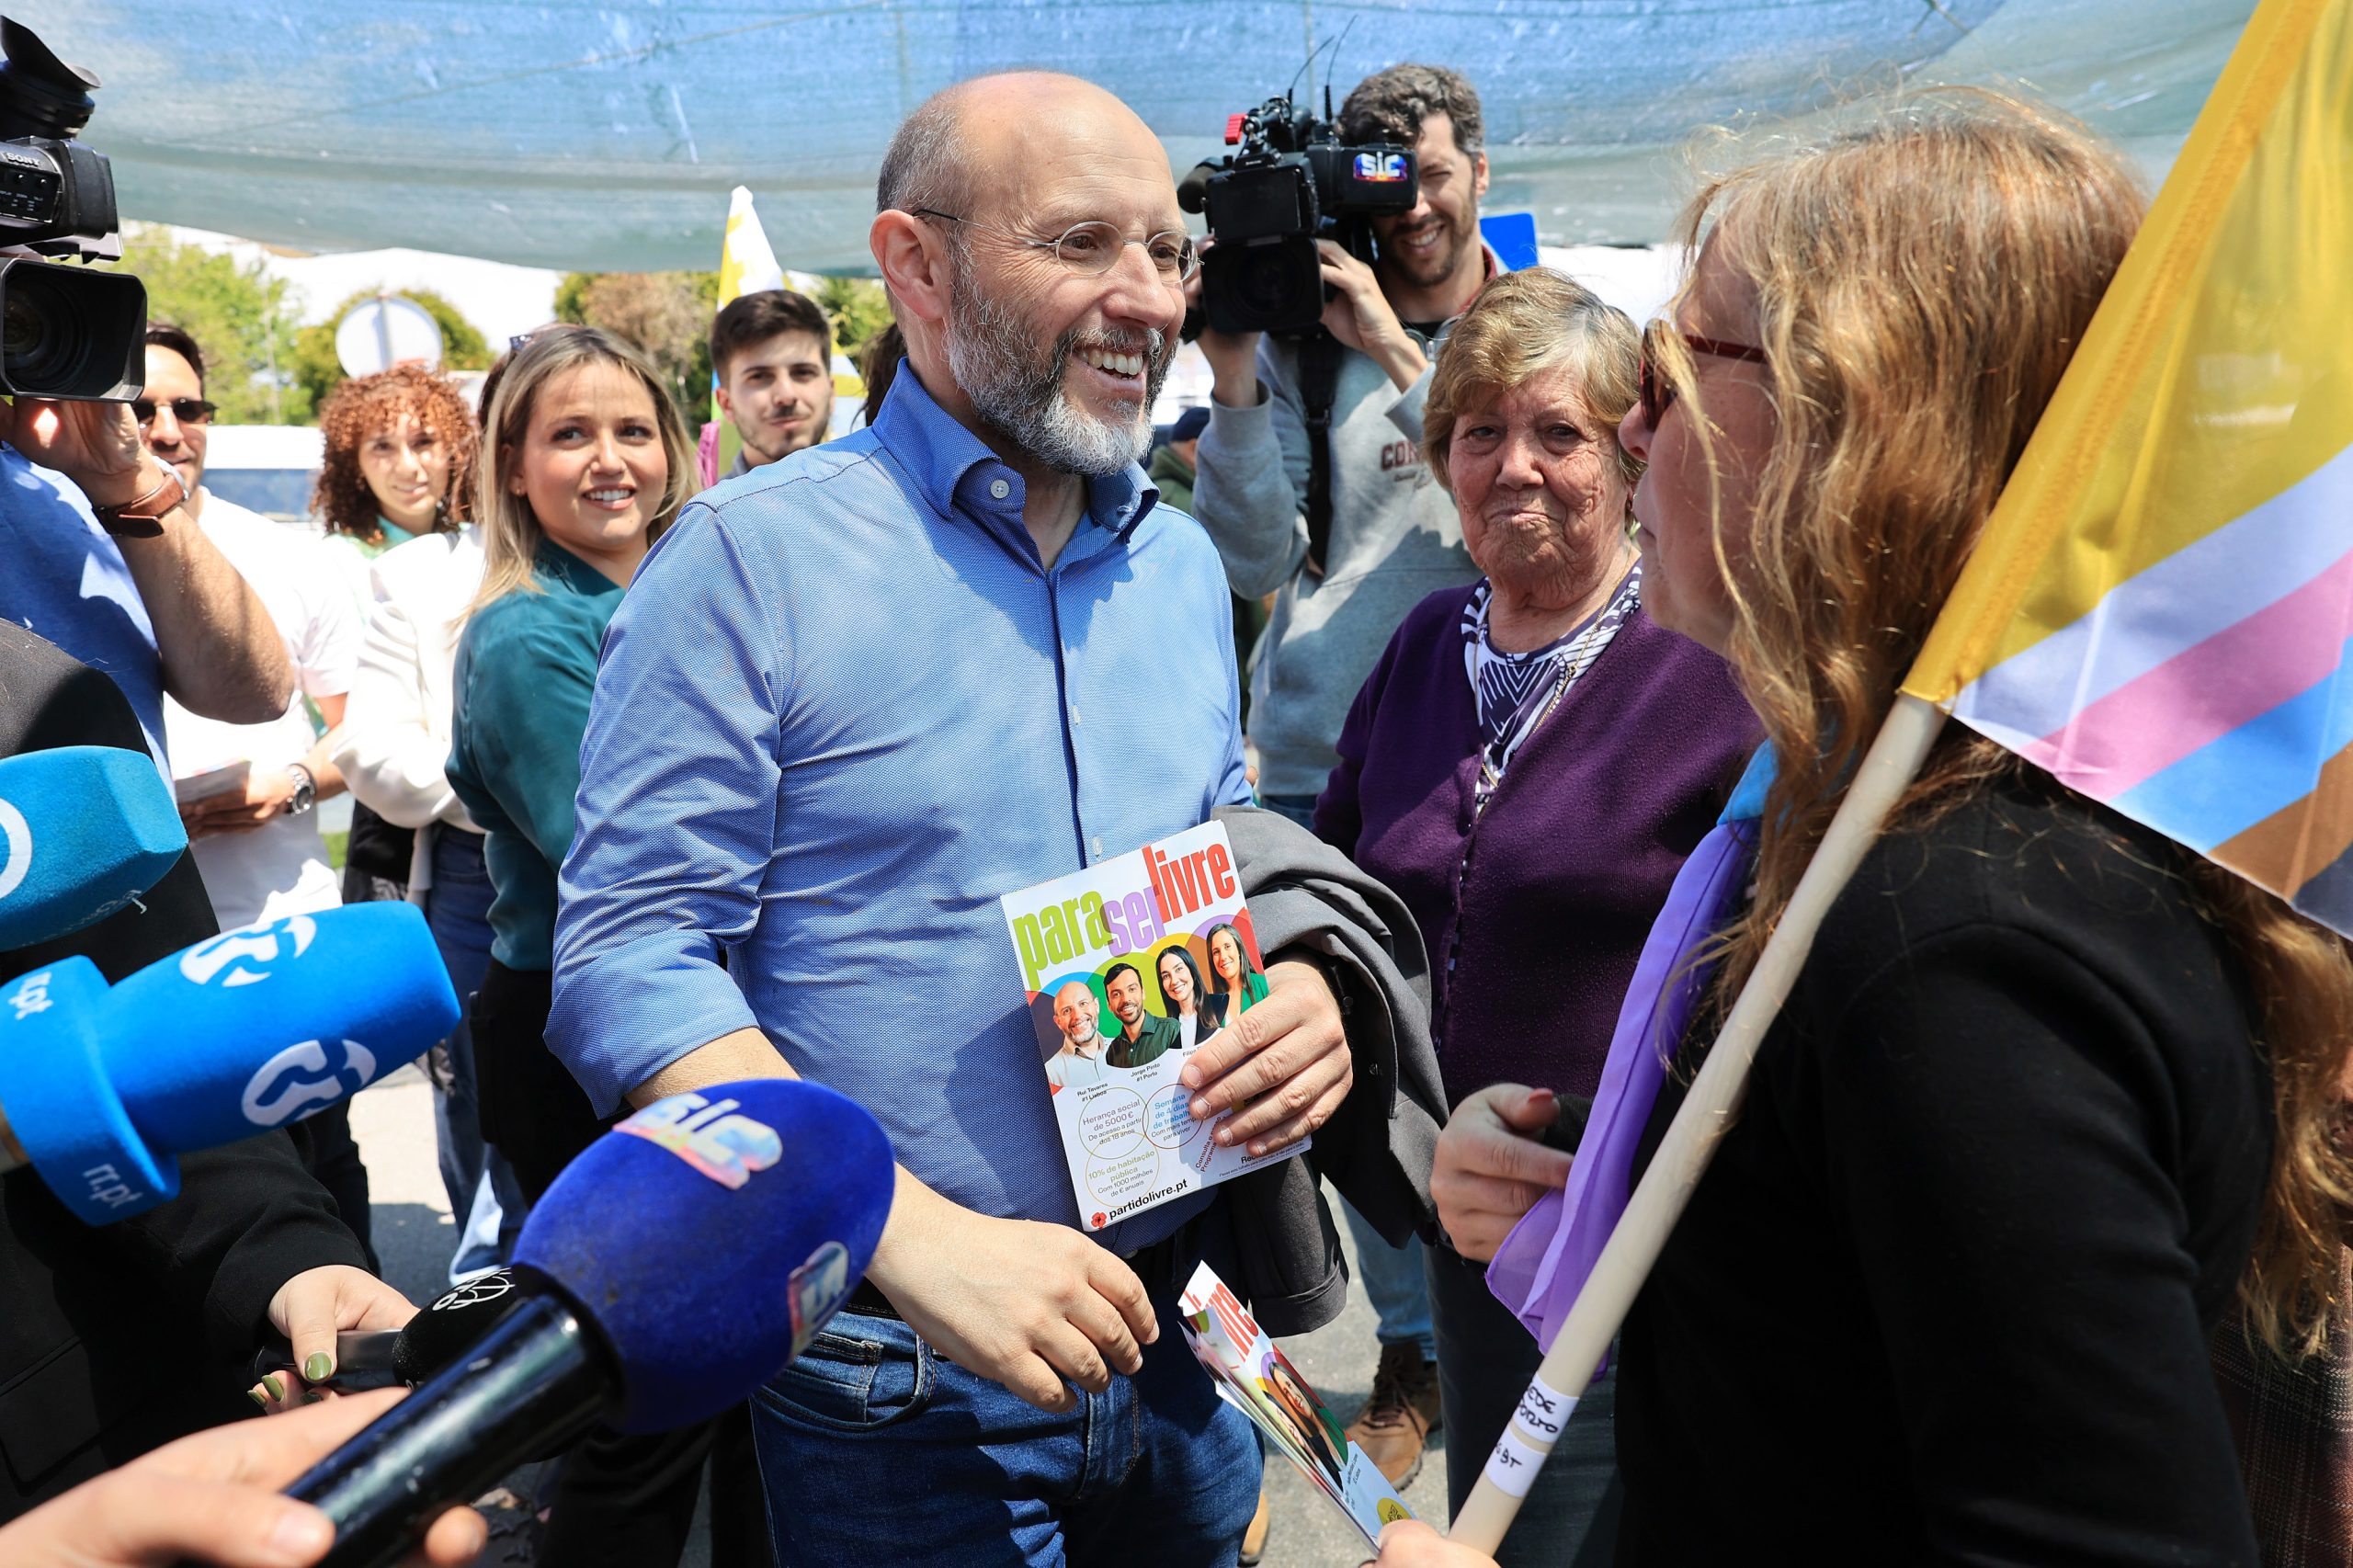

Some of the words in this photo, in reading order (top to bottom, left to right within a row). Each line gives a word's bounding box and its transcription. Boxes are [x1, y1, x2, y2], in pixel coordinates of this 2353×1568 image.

[6, 153, 40, 165] SONY
[1012, 890, 1114, 991] para
[1100, 882, 1165, 958] ser
[1142, 843, 1236, 923] livre
[1083, 1109, 1116, 1125] Herança
[1117, 1098, 1140, 1113] social
[1154, 1094, 1186, 1109] Semana
[1154, 1121, 1163, 1130] de
[1165, 1110, 1190, 1125] trabalh
[1155, 1111, 1165, 1119] de
[1094, 1123, 1104, 1131] de
[1098, 1126, 1120, 1138] acesso
[1126, 1118, 1142, 1129] partir
[1112, 1132, 1120, 1141] 18
[1151, 1128, 1166, 1138] Com
[1166, 1122, 1181, 1131] mais
[1181, 1117, 1197, 1126] temp
[1163, 1131, 1177, 1142] para
[1176, 1126, 1191, 1135] viver
[1196, 1141, 1211, 1168] Consulta
[1088, 1169, 1106, 1180] 10%
[1106, 1165, 1117, 1174] de
[1118, 1151, 1154, 1168] habitação
[1110, 1166, 1139, 1183] pública
[1097, 1186, 1113, 1194] Com
[1114, 1177, 1130, 1187] 1000
[1131, 1169, 1154, 1181] milhões
[1109, 1178, 1188, 1220] partidolivre.pt
